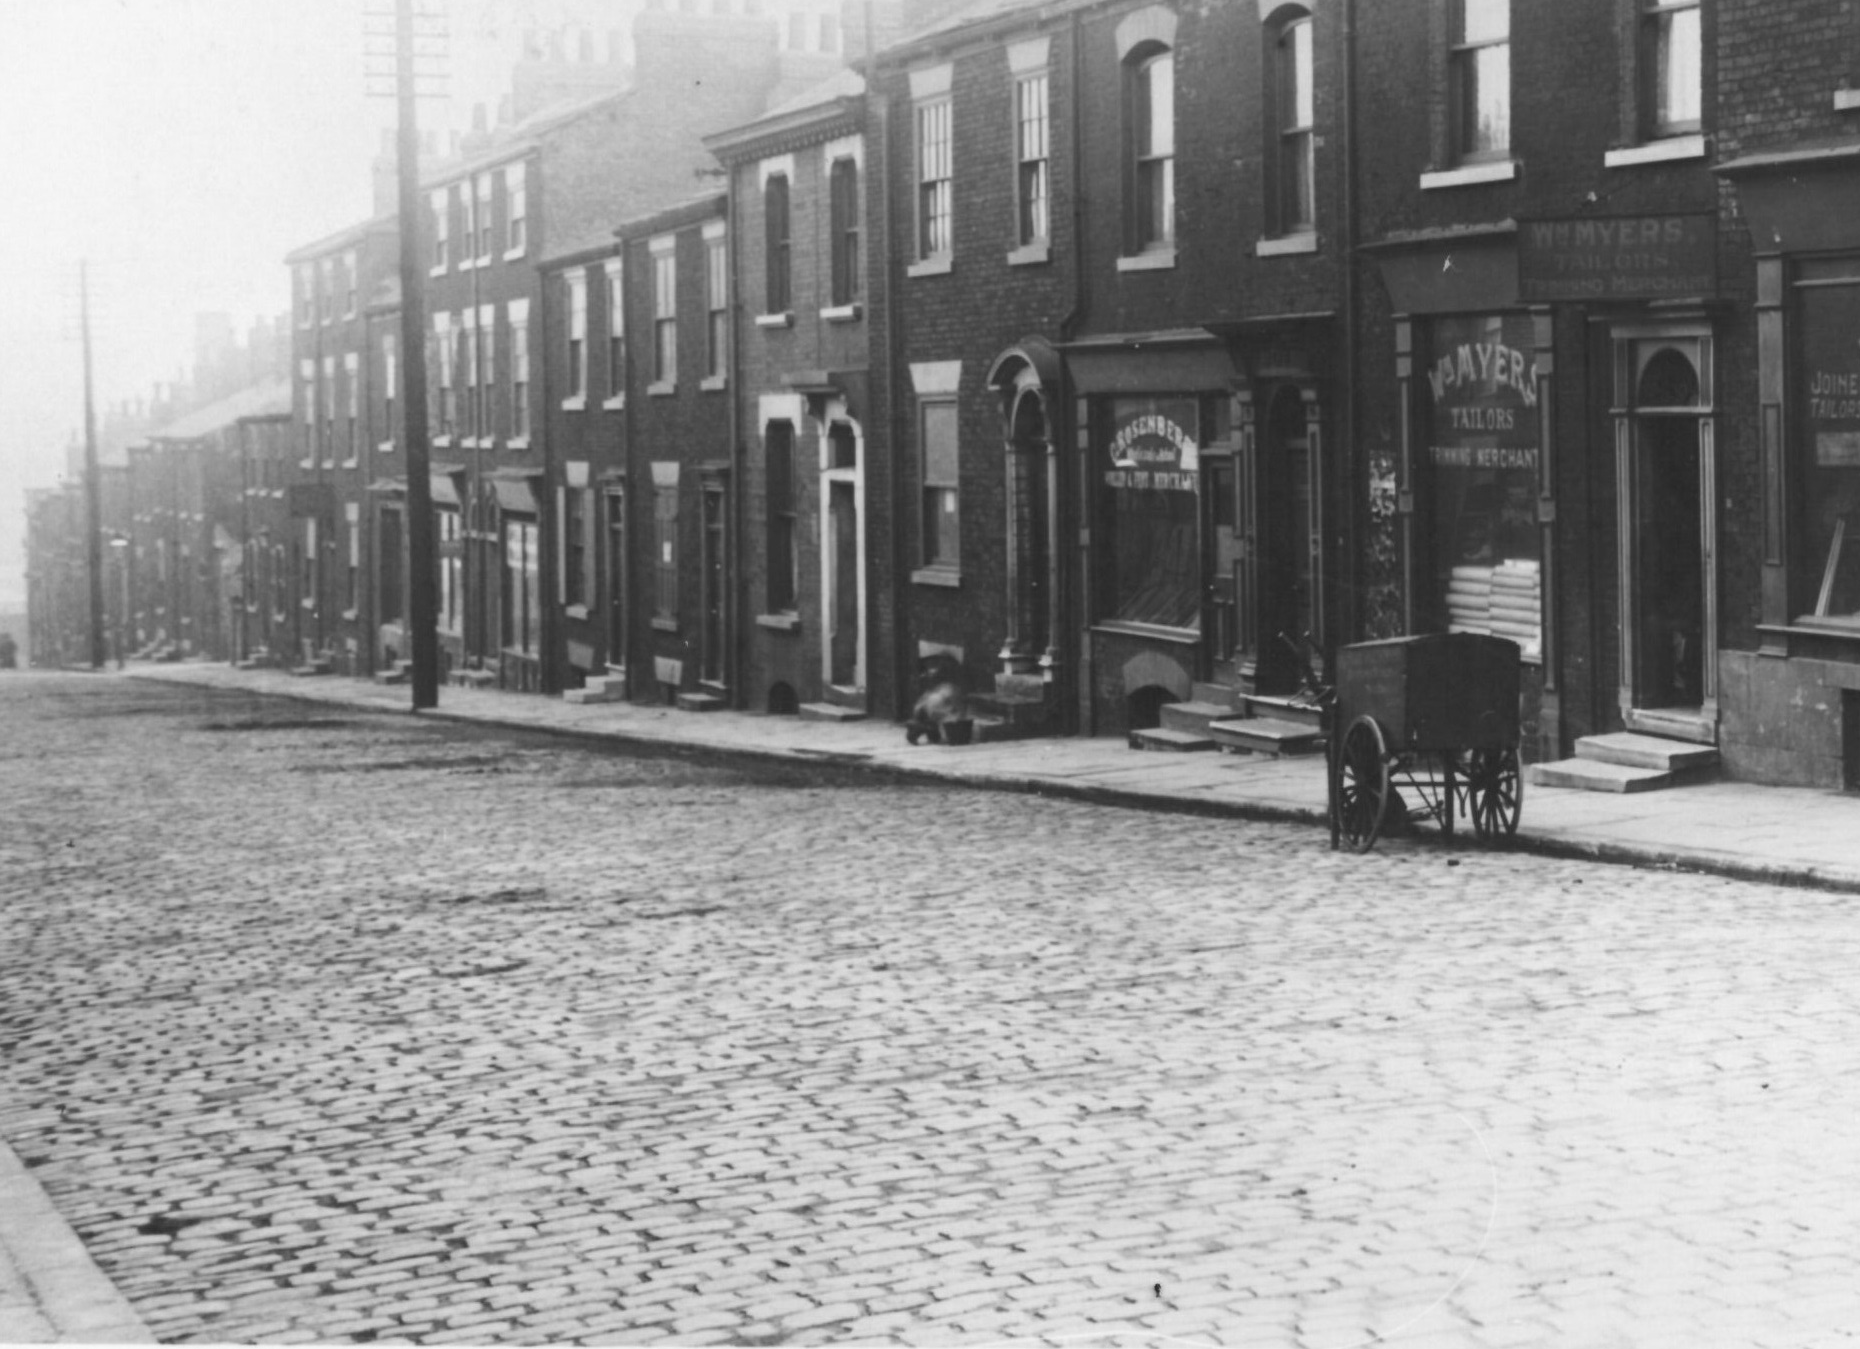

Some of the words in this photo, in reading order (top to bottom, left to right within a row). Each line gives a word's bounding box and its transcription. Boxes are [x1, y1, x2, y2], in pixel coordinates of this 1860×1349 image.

[1456, 342, 1538, 407] MYERS
[1451, 407, 1515, 430] TAILORS
[1115, 415, 1194, 455] ROSENBER
[1477, 448, 1539, 469] MERCHANT
